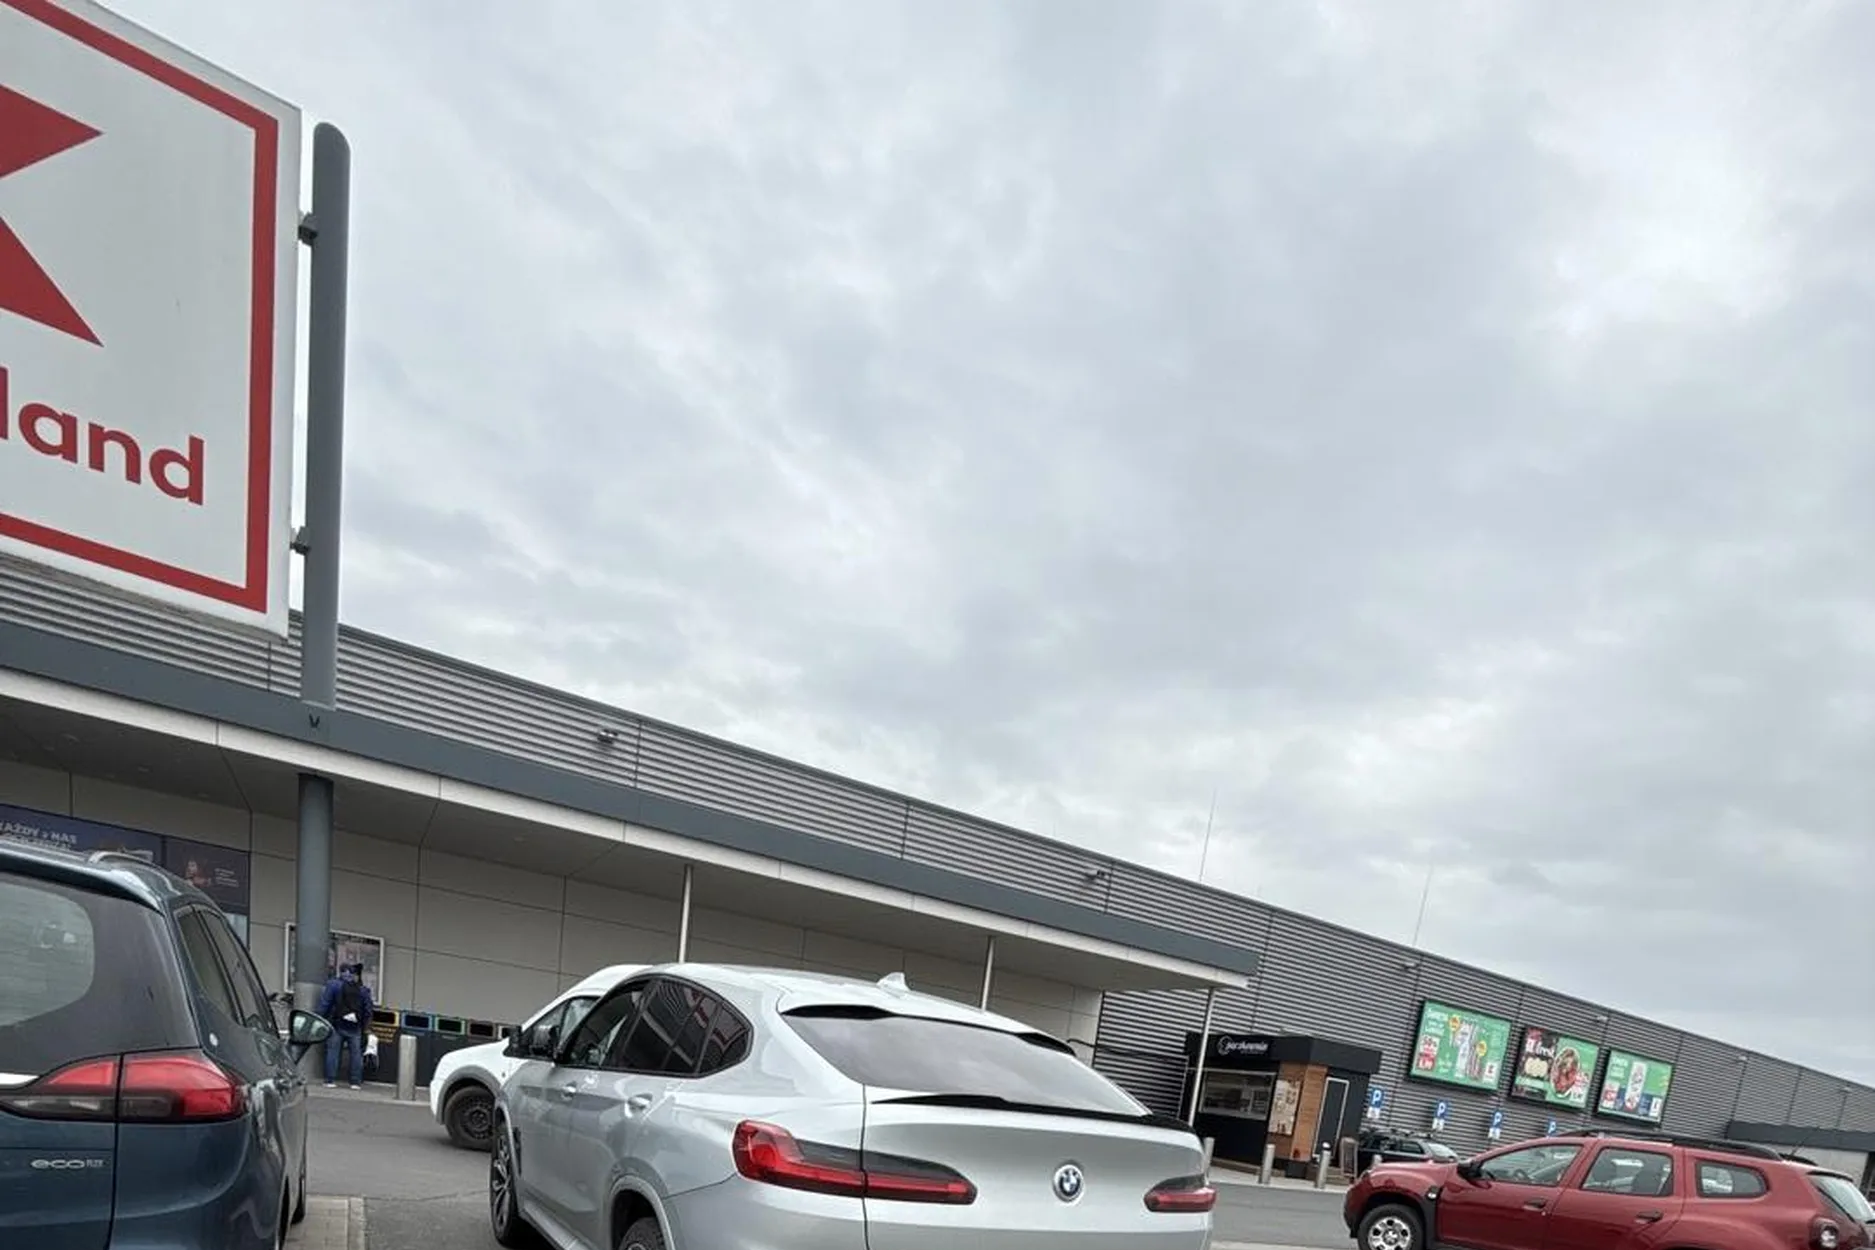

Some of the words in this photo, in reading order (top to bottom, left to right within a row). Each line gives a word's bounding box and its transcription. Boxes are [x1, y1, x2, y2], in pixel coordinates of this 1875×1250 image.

[1372, 1089, 1382, 1105] P
[1437, 1102, 1446, 1117] P
[1493, 1112, 1502, 1126] P
[1548, 1120, 1556, 1134] P
